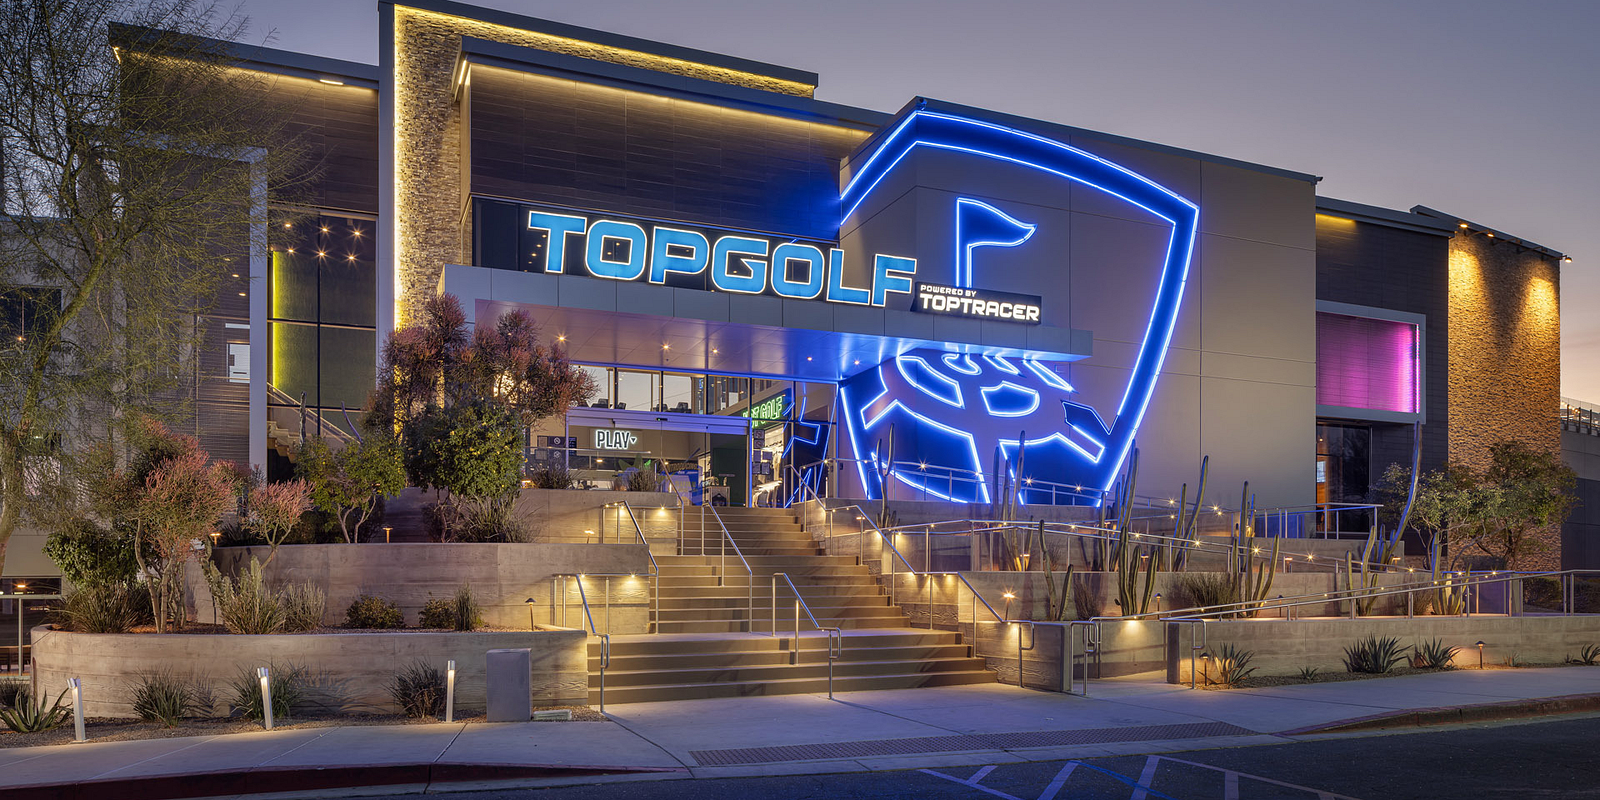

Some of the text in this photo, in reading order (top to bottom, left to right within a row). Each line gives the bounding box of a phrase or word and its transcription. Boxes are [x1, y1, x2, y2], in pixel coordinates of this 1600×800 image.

[528, 211, 917, 307] TOPGOLF
[920, 284, 977, 297] POWERED BY
[920, 293, 1040, 321] TOPTRACER
[760, 396, 783, 425] GOLF
[596, 430, 631, 449] PLAY
